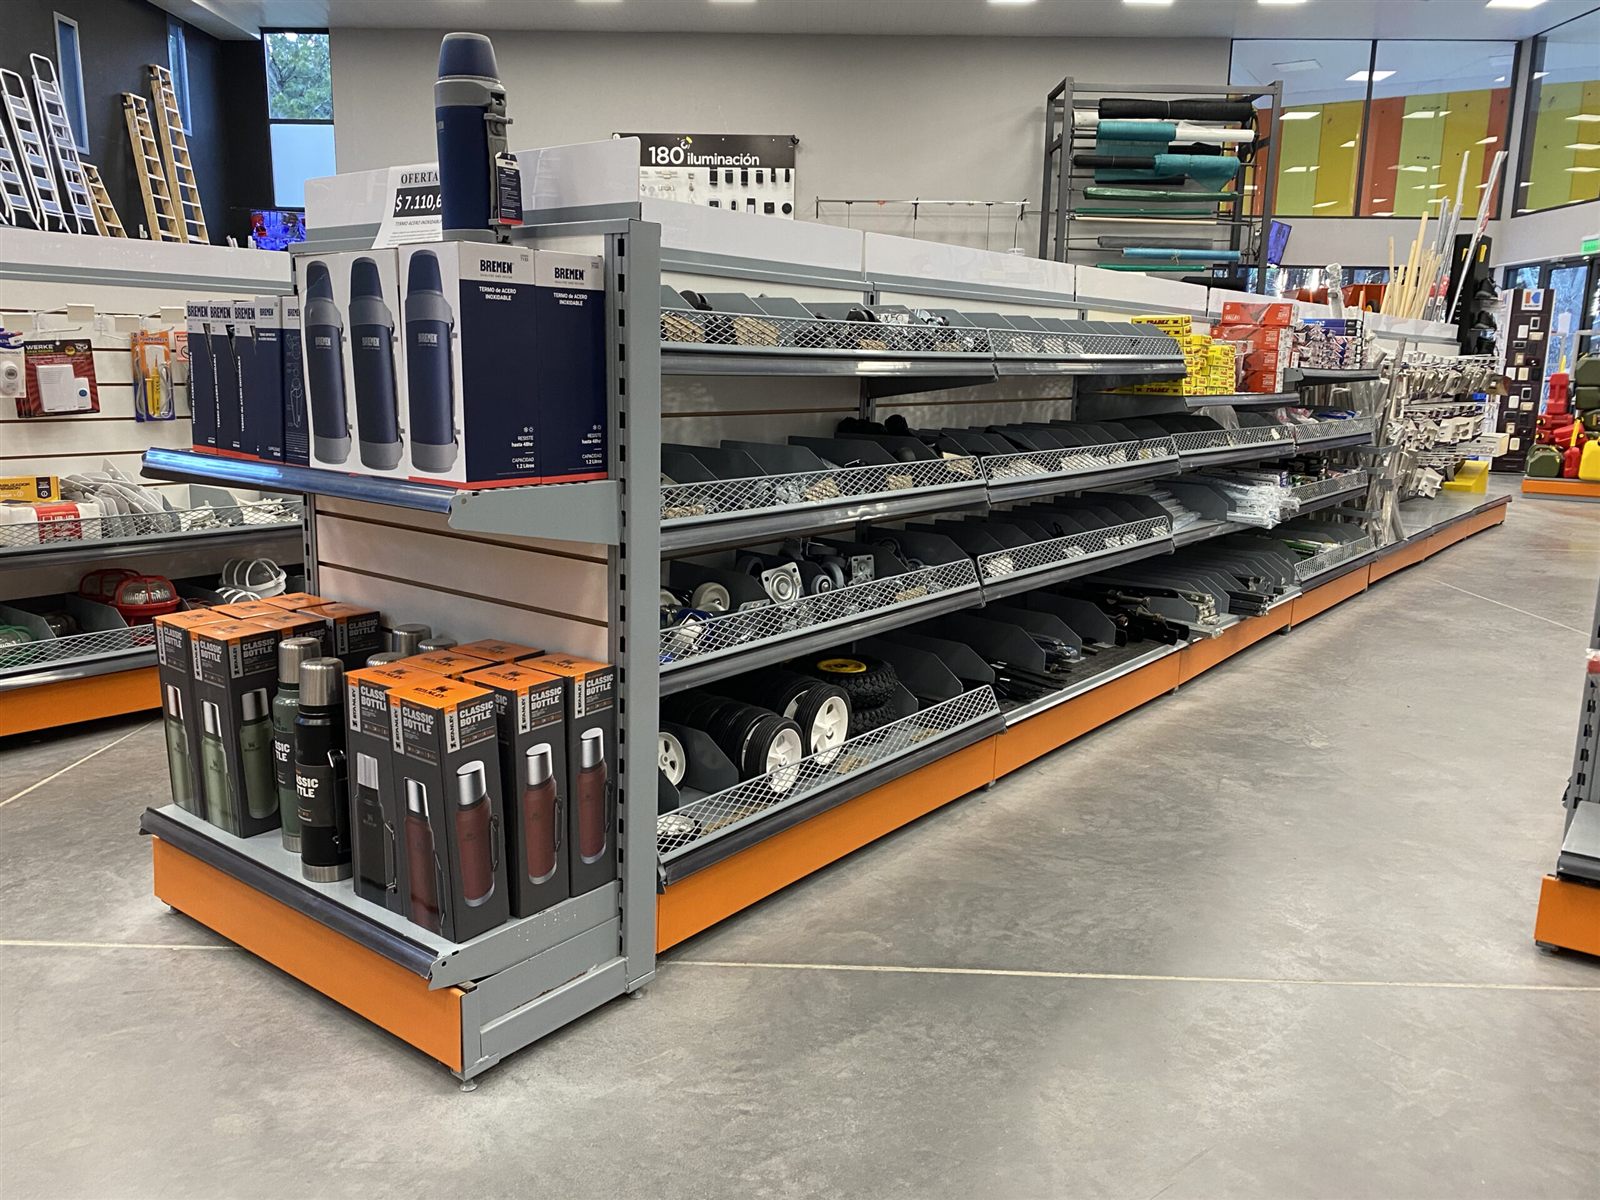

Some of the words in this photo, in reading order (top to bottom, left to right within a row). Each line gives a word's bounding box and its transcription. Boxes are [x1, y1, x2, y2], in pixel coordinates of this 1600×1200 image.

[687, 152, 760, 166] iluminación
[401, 171, 439, 185] OFERTA
[480, 259, 513, 274] BREMEN
[554, 267, 585, 281] BREMEN
[479, 286, 495, 294] TERMO
[501, 287, 517, 295] ACERO
[187, 305, 208, 317] BREMEN
[210, 306, 231, 319] BREMEN
[234, 307, 256, 320] BREMEN
[287, 308, 300, 317] BREME
[349, 619, 378, 630] CLASSIC
[349, 625, 376, 637] BOTTLE
[163, 626, 183, 640] CLASSIC
[164, 635, 182, 648] BOTTLE
[200, 640, 222, 655] CLASSIC
[242, 638, 275, 651] CLASSIC
[200, 649, 221, 663] BOTTLE
[243, 645, 273, 658] BOTTLE
[586, 673, 614, 688] CLASSIC
[360, 686, 386, 701] CLASSI
[531, 686, 562, 702] CLASSIC
[586, 681, 612, 696] BOTTLE
[459, 700, 494, 719] CLASSIC
[531, 695, 560, 710] BOTTLE
[402, 706, 434, 725] CLASSIC
[460, 710, 492, 728] BOTTLE
[403, 717, 432, 735] BOTTLE
